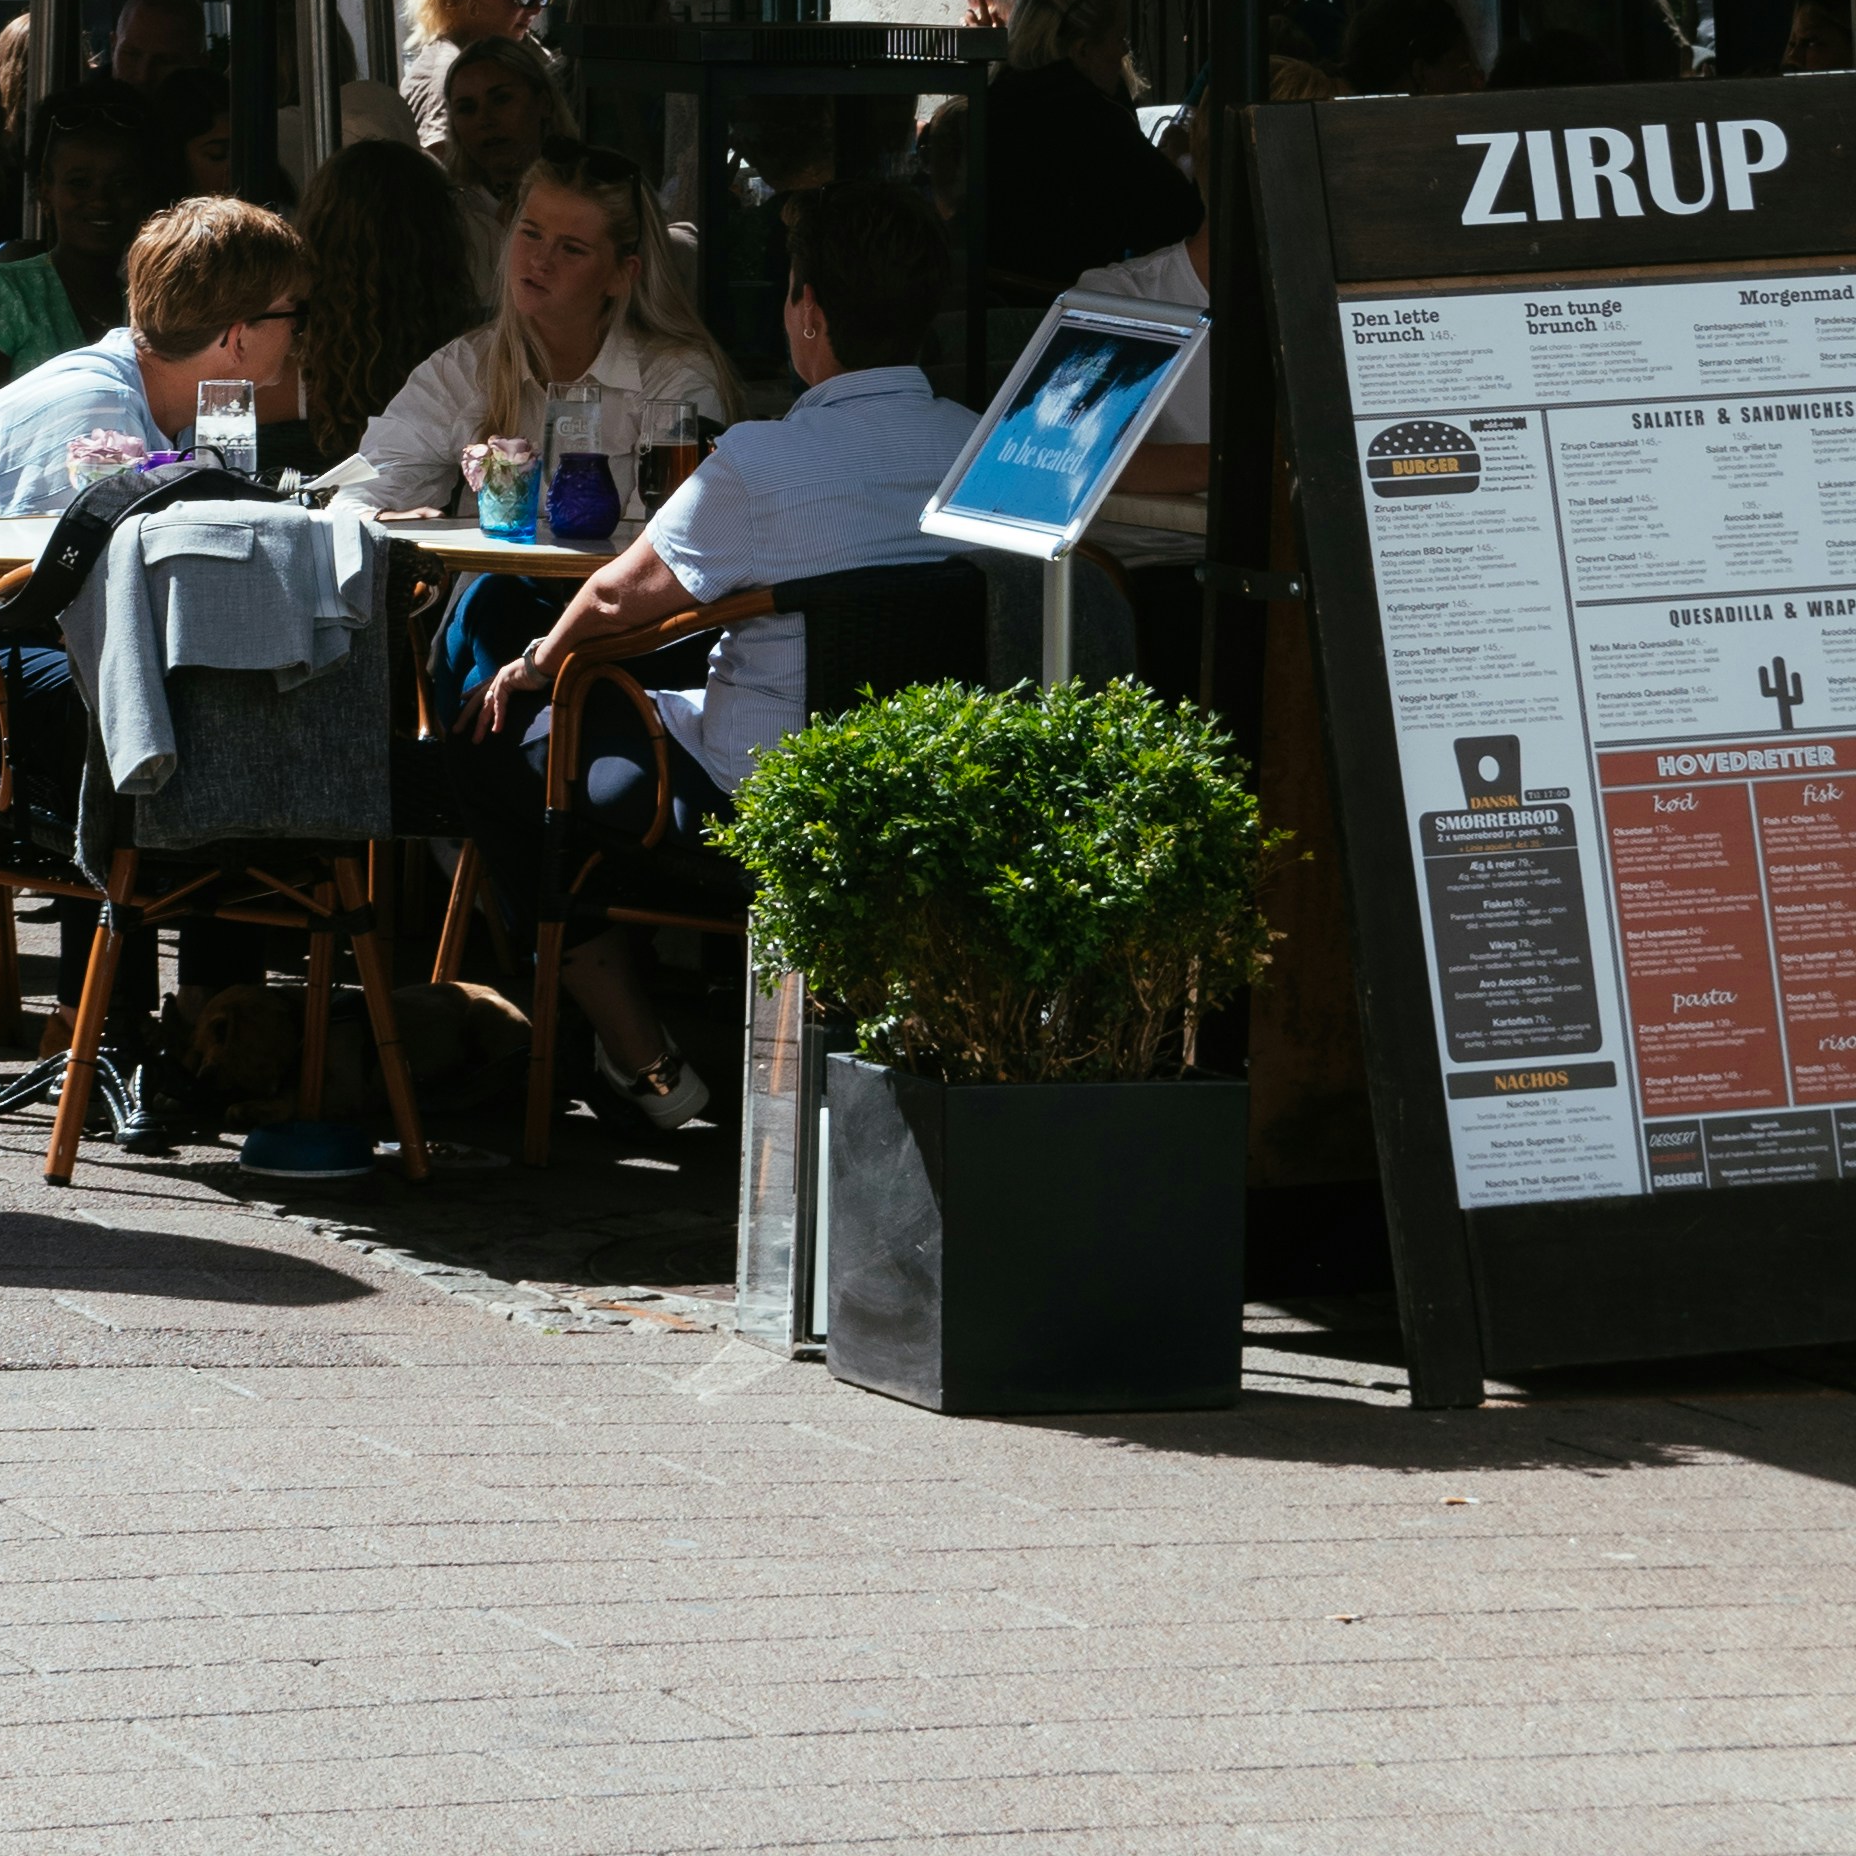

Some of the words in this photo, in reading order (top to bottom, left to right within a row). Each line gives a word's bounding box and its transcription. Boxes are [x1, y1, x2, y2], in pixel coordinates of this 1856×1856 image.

[1455, 118, 1789, 226] ZIRUP
[1738, 285, 1855, 307] Morgenmad
[1524, 302, 1563, 318] Den
[1567, 299, 1622, 317] tunge
[1351, 311, 1390, 328] Den
[1394, 308, 1440, 325] lette
[1526, 318, 1598, 335] brunch
[1353, 327, 1425, 345] brunch
[1698, 358, 1732, 368] Serrano
[1733, 356, 1763, 366] omelet
[1819, 352, 1837, 361] Stor
[1631, 409, 1705, 430] SALATER
[1717, 407, 1731, 425] &
[1740, 400, 1855, 424] SANDWICHES
[1560, 442, 1588, 452] Zirups
[1705, 445, 1728, 454] Salat
[1742, 443, 1767, 453] grillet
[998, 437, 1017, 463] to
[1016, 436, 1036, 466] be
[1034, 446, 1089, 476] seated
[1392, 457, 1460, 476] BURGER
[1374, 503, 1402, 513] Zirups
[1403, 502, 1432, 512] burger
[1568, 498, 1587, 507] Thai
[1588, 496, 1608, 506] Beef
[1610, 495, 1633, 505] salad
[1723, 513, 1761, 523] Avocado
[1379, 549, 1422, 559] American
[1423, 546, 1444, 556] BBQ
[1445, 545, 1474, 555] burger
[1607, 552, 1636, 562] Chaud
[1386, 601, 1449, 613] Kyllingeburger
[1669, 604, 1773, 628] QUESADILLA
[1784, 601, 1797, 619] &
[1392, 648, 1421, 659] Zirups
[1451, 645, 1481, 655] burger
[1589, 644, 1610, 652] Miss
[1612, 642, 1637, 650] Maria
[1638, 639, 1684, 650] Quesadilla
[1398, 694, 1428, 704] Veggie
[1429, 692, 1459, 702] burger
[1596, 691, 1642, 701] Fernandos
[1644, 687, 1689, 697] Quesadilla
[1657, 745, 1837, 777] HOVEDRETTER
[1801, 782, 1844, 806] fisk
[1469, 795, 1519, 810] DANSK
[1652, 792, 1700, 813] kød
[1434, 808, 1559, 833] SMØRREBRØD
[1452, 830, 1504, 842] smørrebrød
[1496, 859, 1516, 870] rejer
[1482, 899, 1513, 910] Fisken
[1488, 940, 1518, 951] Viking
[1479, 979, 1497, 989] Avo
[1497, 976, 1537, 988] Avocado
[1671, 988, 1738, 1014] pasta
[1492, 1017, 1534, 1028] Kartoflen
[1494, 1069, 1570, 1091] NACHOS
[1506, 1099, 1540, 1109] Nachos
[1490, 1139, 1525, 1149] Nachos
[1526, 1136, 1565, 1147] Supreme
[1649, 1130, 1697, 1148] DESSERT
[1485, 1179, 1519, 1189] Nachos
[1520, 1177, 1540, 1186] Thai
[1541, 1174, 1580, 1185] Supreme
[1653, 1170, 1704, 1188] DESSERT
